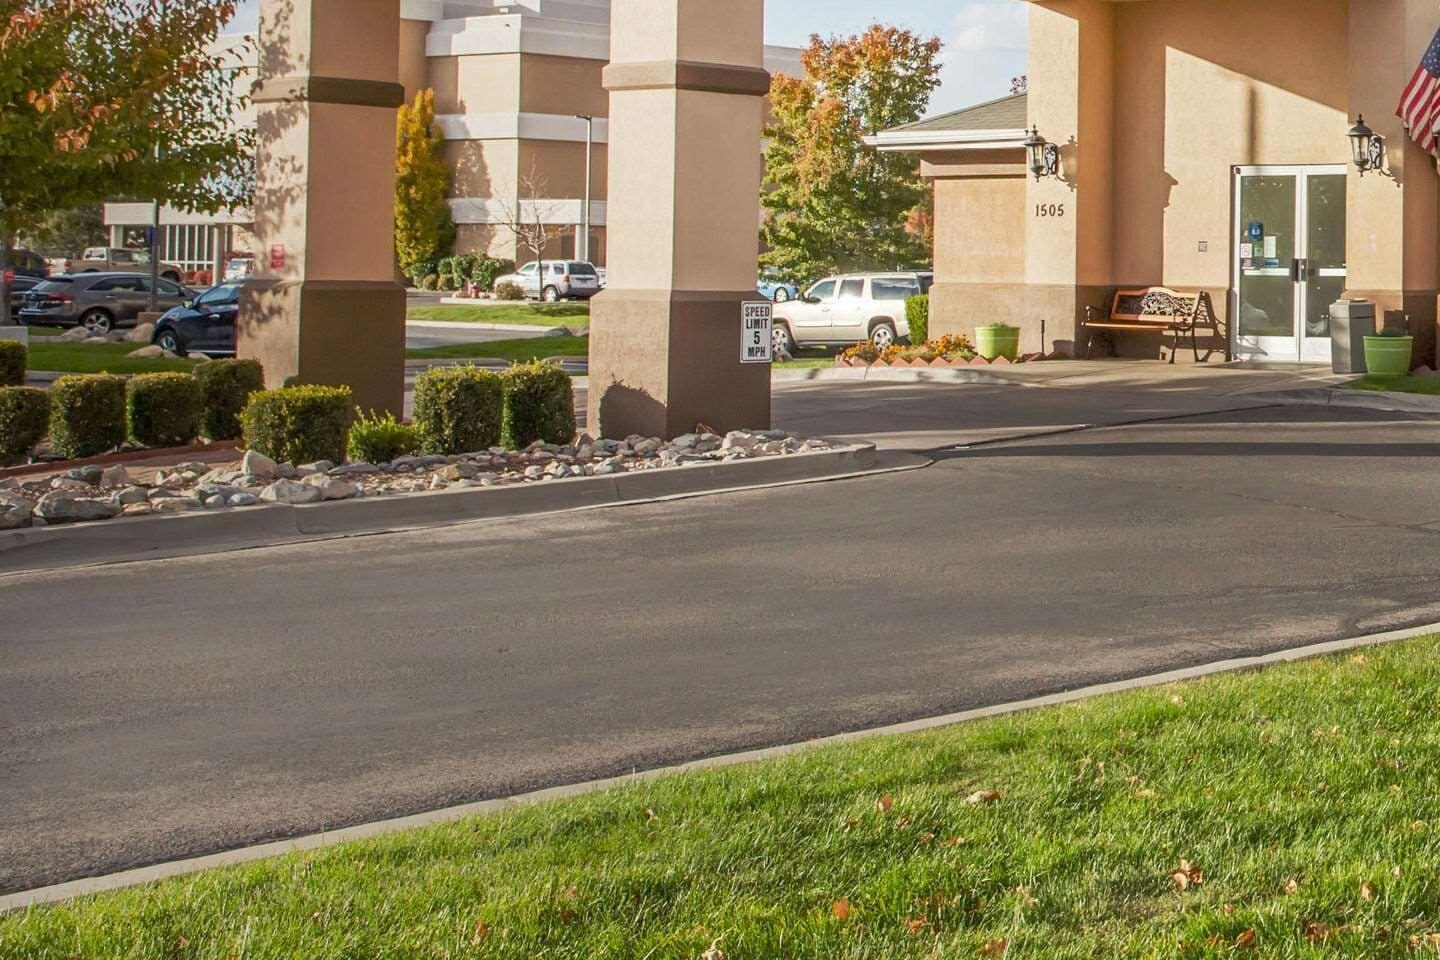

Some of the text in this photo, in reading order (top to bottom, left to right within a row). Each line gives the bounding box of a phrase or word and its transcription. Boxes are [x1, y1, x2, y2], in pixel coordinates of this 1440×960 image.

[1036, 203, 1064, 217] 1505
[745, 306, 770, 317] SPEED
[746, 318, 768, 329] LIMIT
[753, 331, 760, 345] 5
[748, 346, 766, 357] MPH
